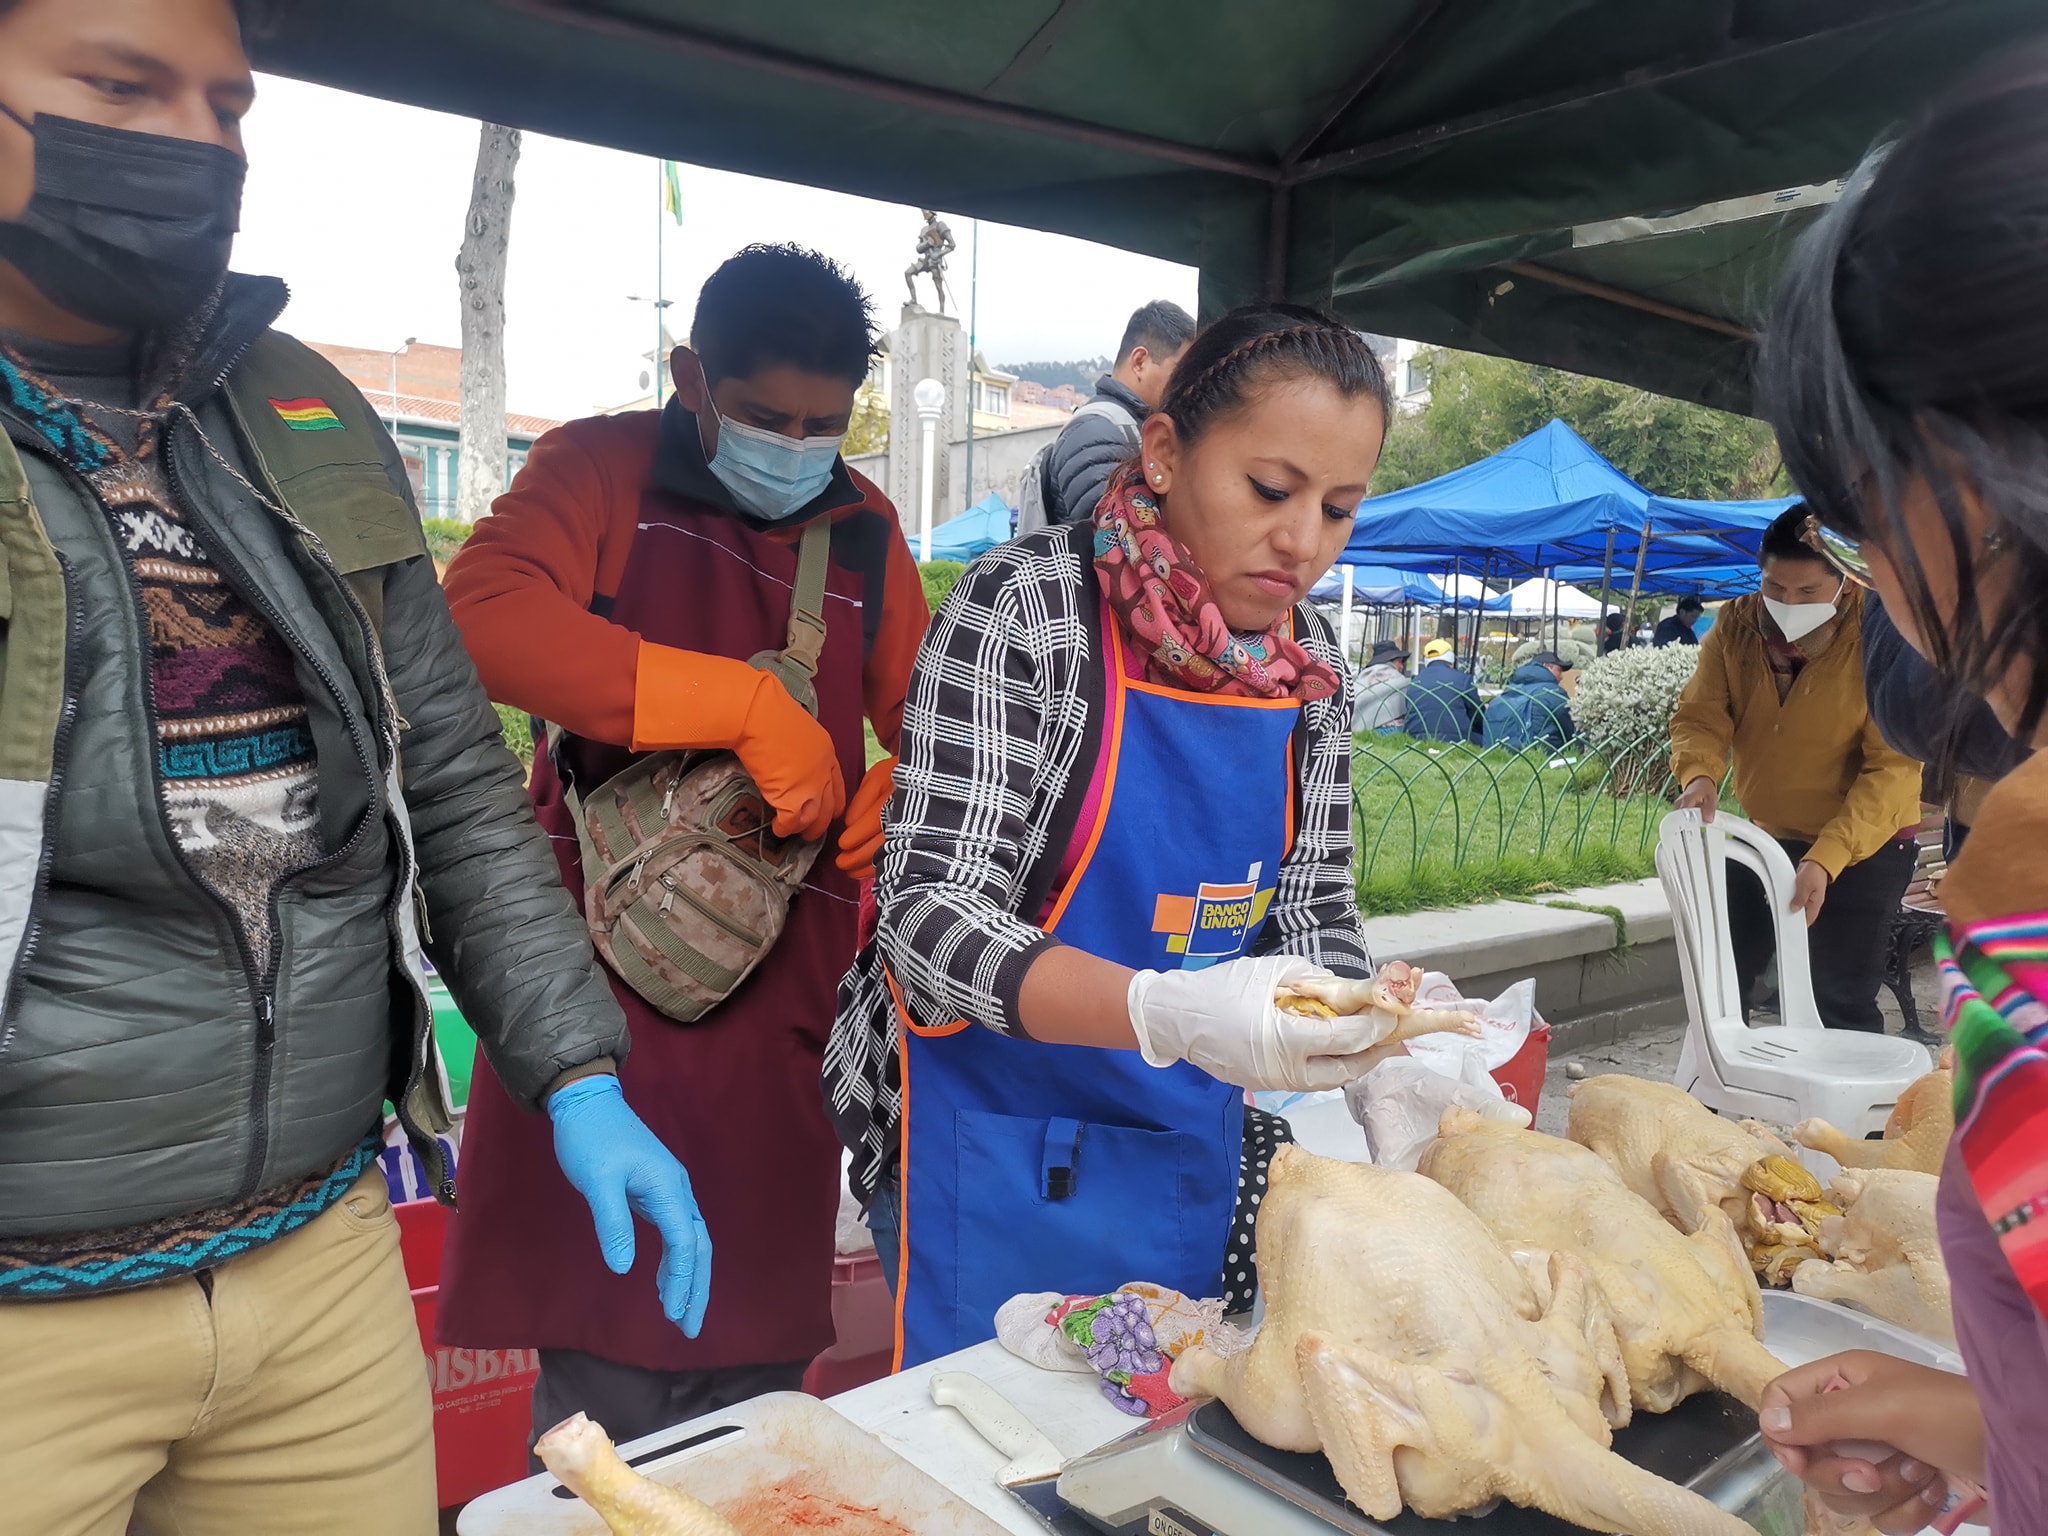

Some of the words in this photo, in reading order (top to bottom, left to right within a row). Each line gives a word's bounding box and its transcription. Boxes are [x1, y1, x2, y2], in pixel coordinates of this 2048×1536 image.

[1202, 901, 1250, 917] BANCO
[1200, 914, 1247, 929] UNION
[1154, 1517, 1166, 1534] ON
